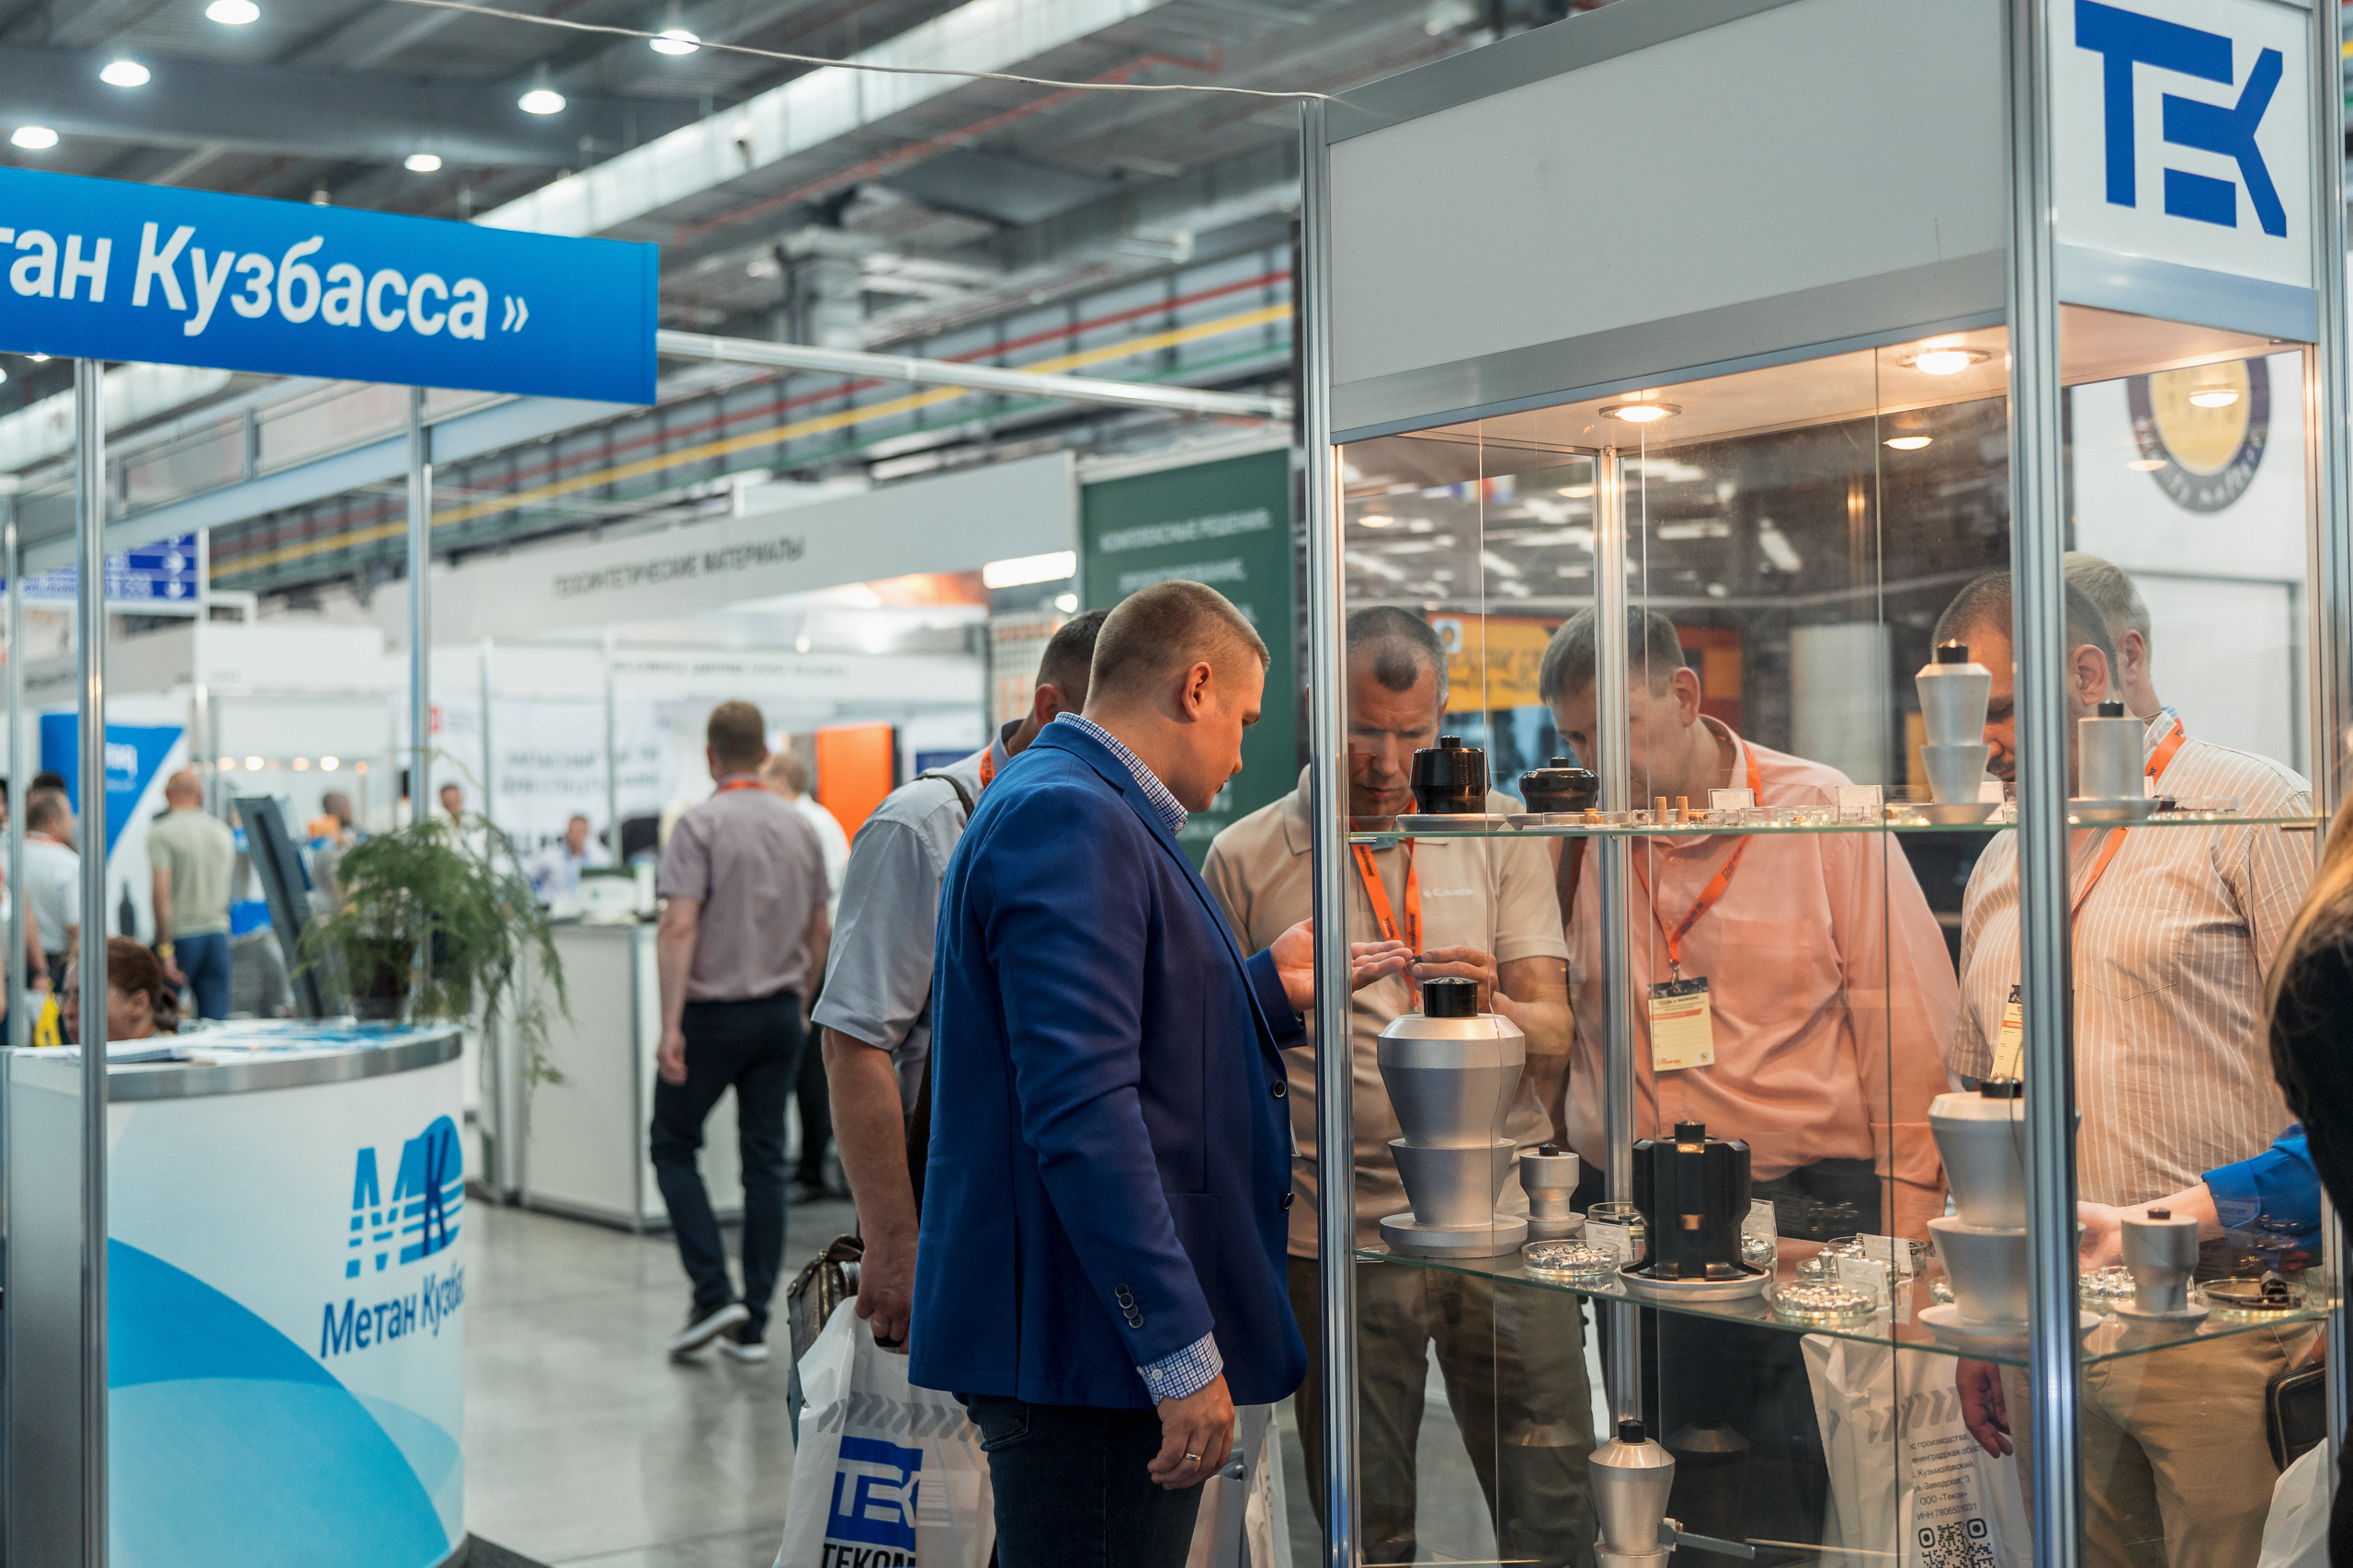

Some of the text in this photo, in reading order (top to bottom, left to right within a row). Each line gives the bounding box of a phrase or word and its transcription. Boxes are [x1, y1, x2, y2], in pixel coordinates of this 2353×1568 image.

[320, 1292, 417, 1358] Метан
[1920, 1494, 1937, 1506] ООО
[1916, 1510, 1934, 1521] ИНН
